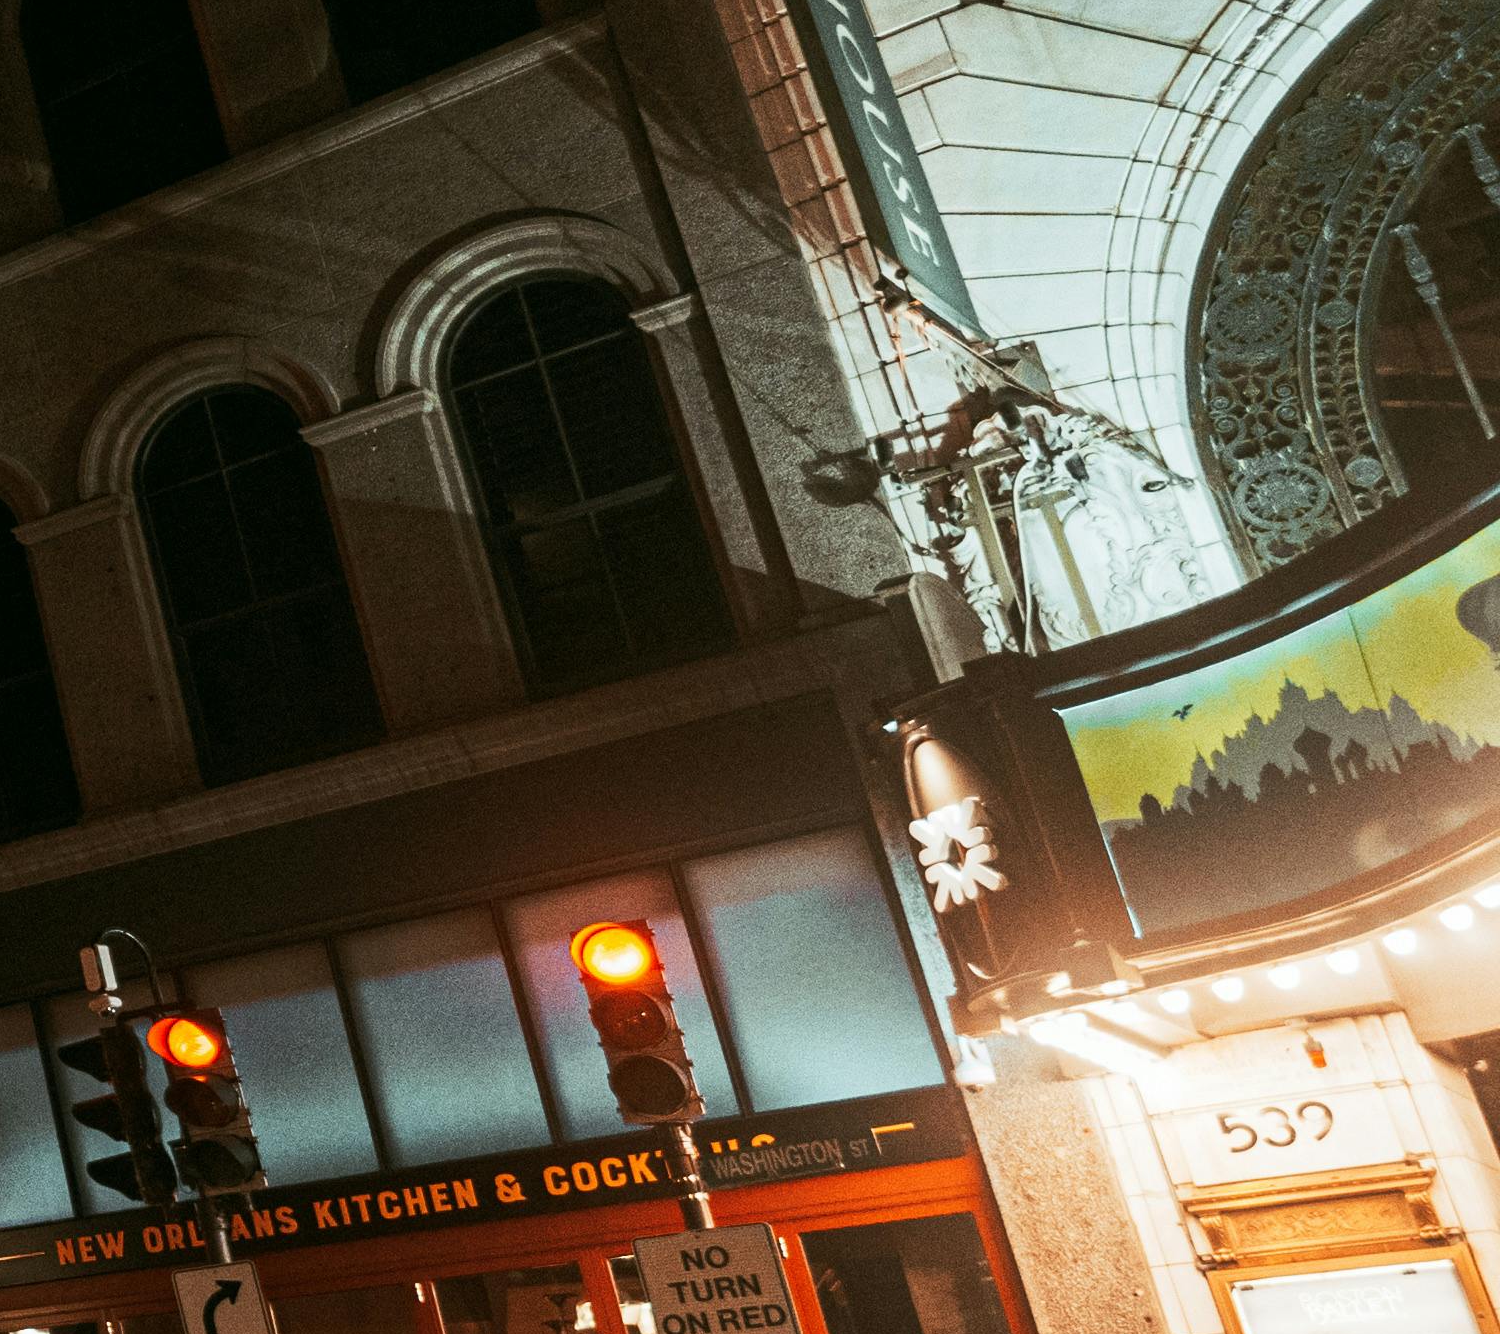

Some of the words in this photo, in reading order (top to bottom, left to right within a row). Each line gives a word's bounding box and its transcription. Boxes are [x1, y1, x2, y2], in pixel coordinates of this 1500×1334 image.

[1216, 1101, 1333, 1153] 539
[709, 1137, 844, 1179] WASHINGTON
[850, 1138, 871, 1159] ST
[55, 1232, 124, 1265] NEW
[141, 1207, 301, 1253] ORLANS
[312, 1184, 479, 1230] KITCHEN
[495, 1171, 527, 1203] &
[680, 1245, 730, 1271] NO
[667, 1273, 762, 1304] TURN
[719, 1303, 787, 1333] RED
